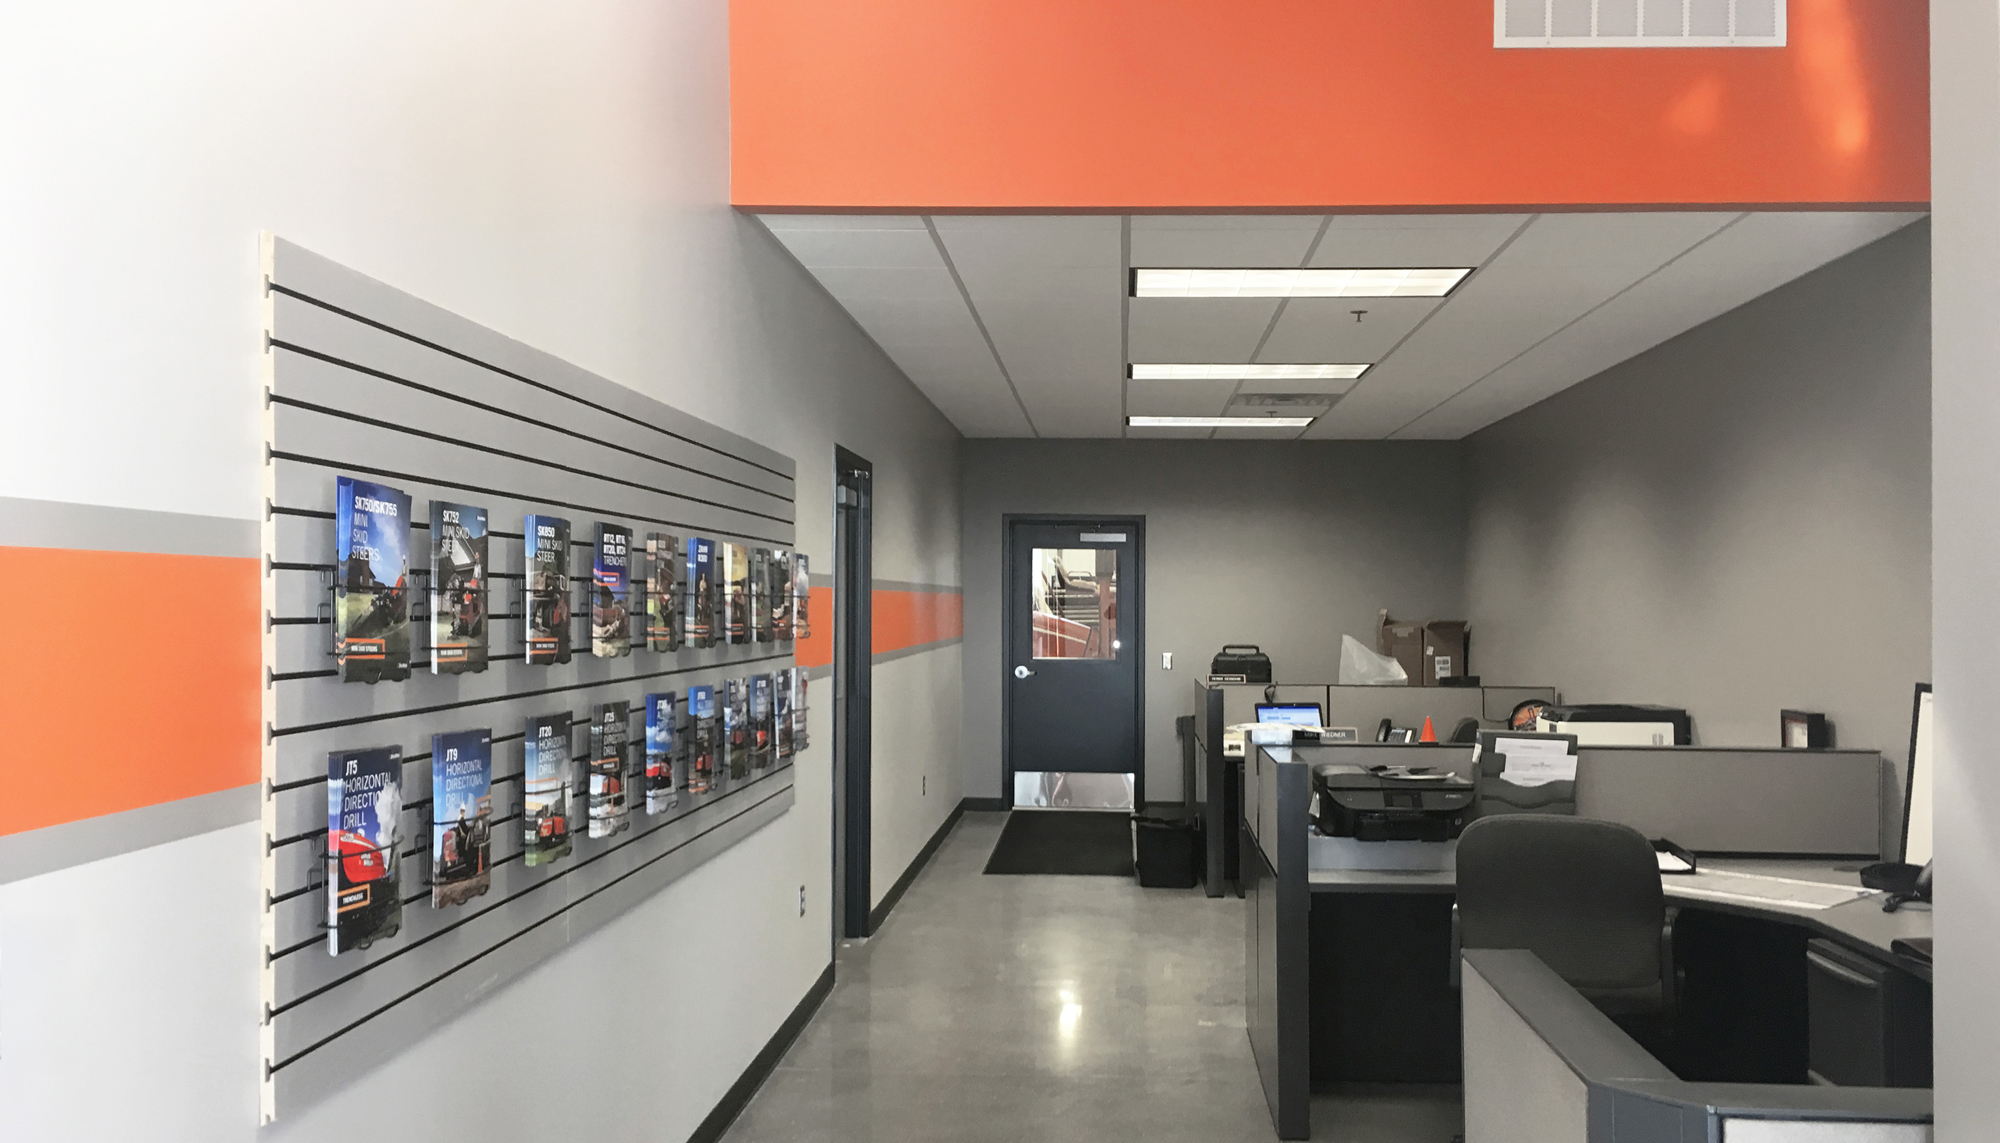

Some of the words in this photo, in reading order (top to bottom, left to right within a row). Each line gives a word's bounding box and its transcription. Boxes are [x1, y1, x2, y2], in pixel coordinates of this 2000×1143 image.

[354, 495, 398, 517] SK750/SK755
[354, 512, 368, 528] MINI
[442, 509, 460, 524] SK752
[352, 528, 368, 544] SKID
[455, 525, 470, 540] SKID
[537, 525, 556, 538] SK850
[537, 538, 551, 550] MINI
[351, 544, 380, 562] STEERS
[536, 550, 556, 563] STEER
[538, 725, 553, 739] JT20
[446, 747, 459, 762] JT9
[345, 759, 359, 777] JT5
[446, 759, 483, 777] HORIZONTAL
[538, 761, 556, 776] DRILL
[345, 771, 392, 794] HORIZONTAL
[445, 773, 484, 792] DIRECTIONAL
[344, 790, 381, 813] DIRECTIO
[445, 791, 465, 808] DRILL
[343, 811, 367, 830] DRILL
